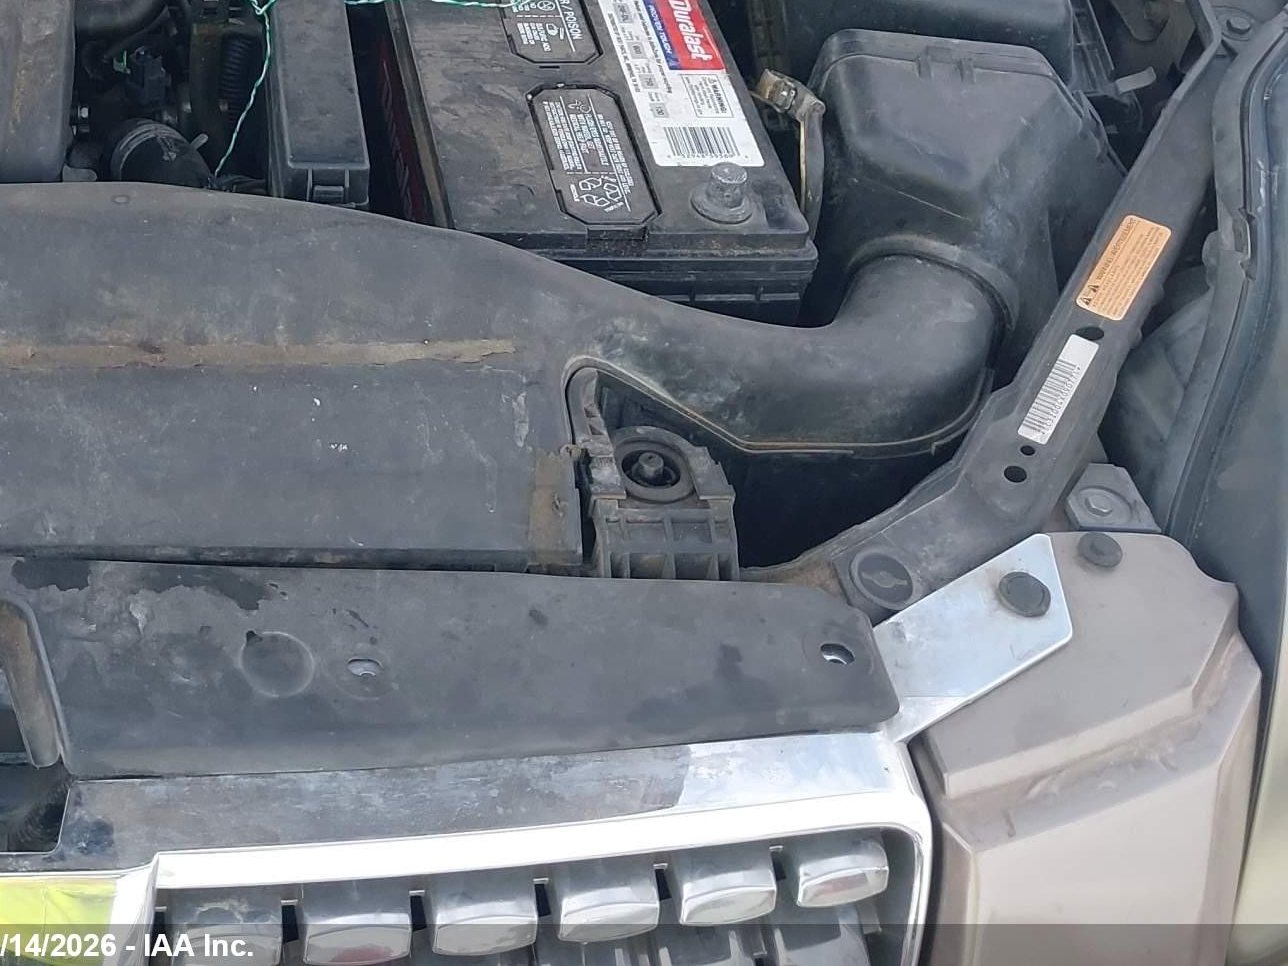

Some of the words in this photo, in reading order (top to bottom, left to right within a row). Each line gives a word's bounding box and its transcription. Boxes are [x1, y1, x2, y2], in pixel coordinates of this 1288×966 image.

[563, 11, 582, 39] POISON
[646, 4, 664, 30] PROVEN
[657, 31, 673, 54] TOUGH
